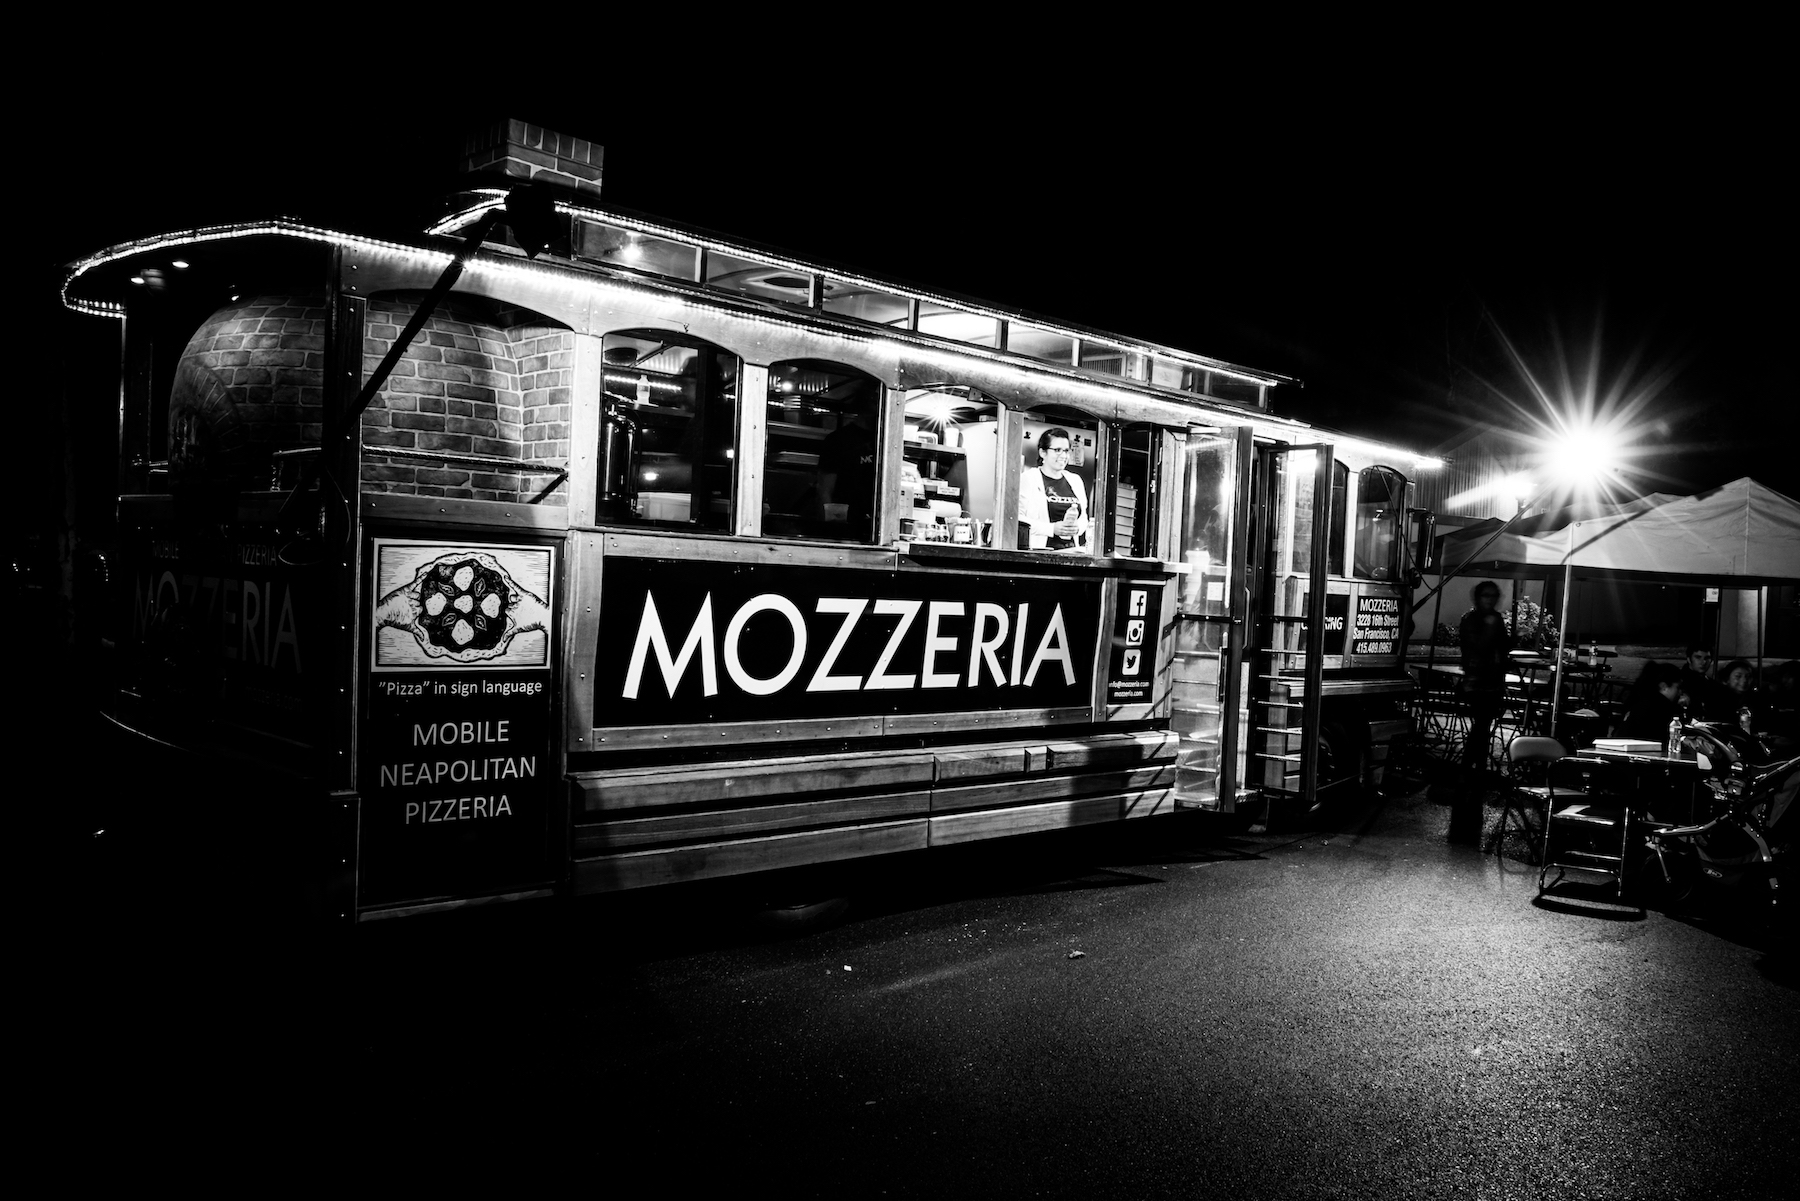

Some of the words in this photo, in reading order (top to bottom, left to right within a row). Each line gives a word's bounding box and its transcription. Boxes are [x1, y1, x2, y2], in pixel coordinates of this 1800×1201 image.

[237, 543, 278, 566] PIZZERIA
[1360, 599, 1398, 612] MOZZERIA
[1357, 614, 1371, 626] 3228
[1384, 614, 1399, 626] Street
[622, 589, 1076, 699] MOZZERIA
[1353, 627, 1365, 639] San
[1364, 627, 1390, 640] Francisco,
[1391, 627, 1399, 639] CA
[434, 681, 447, 694] in
[450, 680, 478, 697] sign
[482, 680, 542, 696] language
[413, 720, 509, 746] MOBILE
[380, 756, 536, 788] NEAPOLITAN
[405, 794, 512, 825] PIZZERIA
